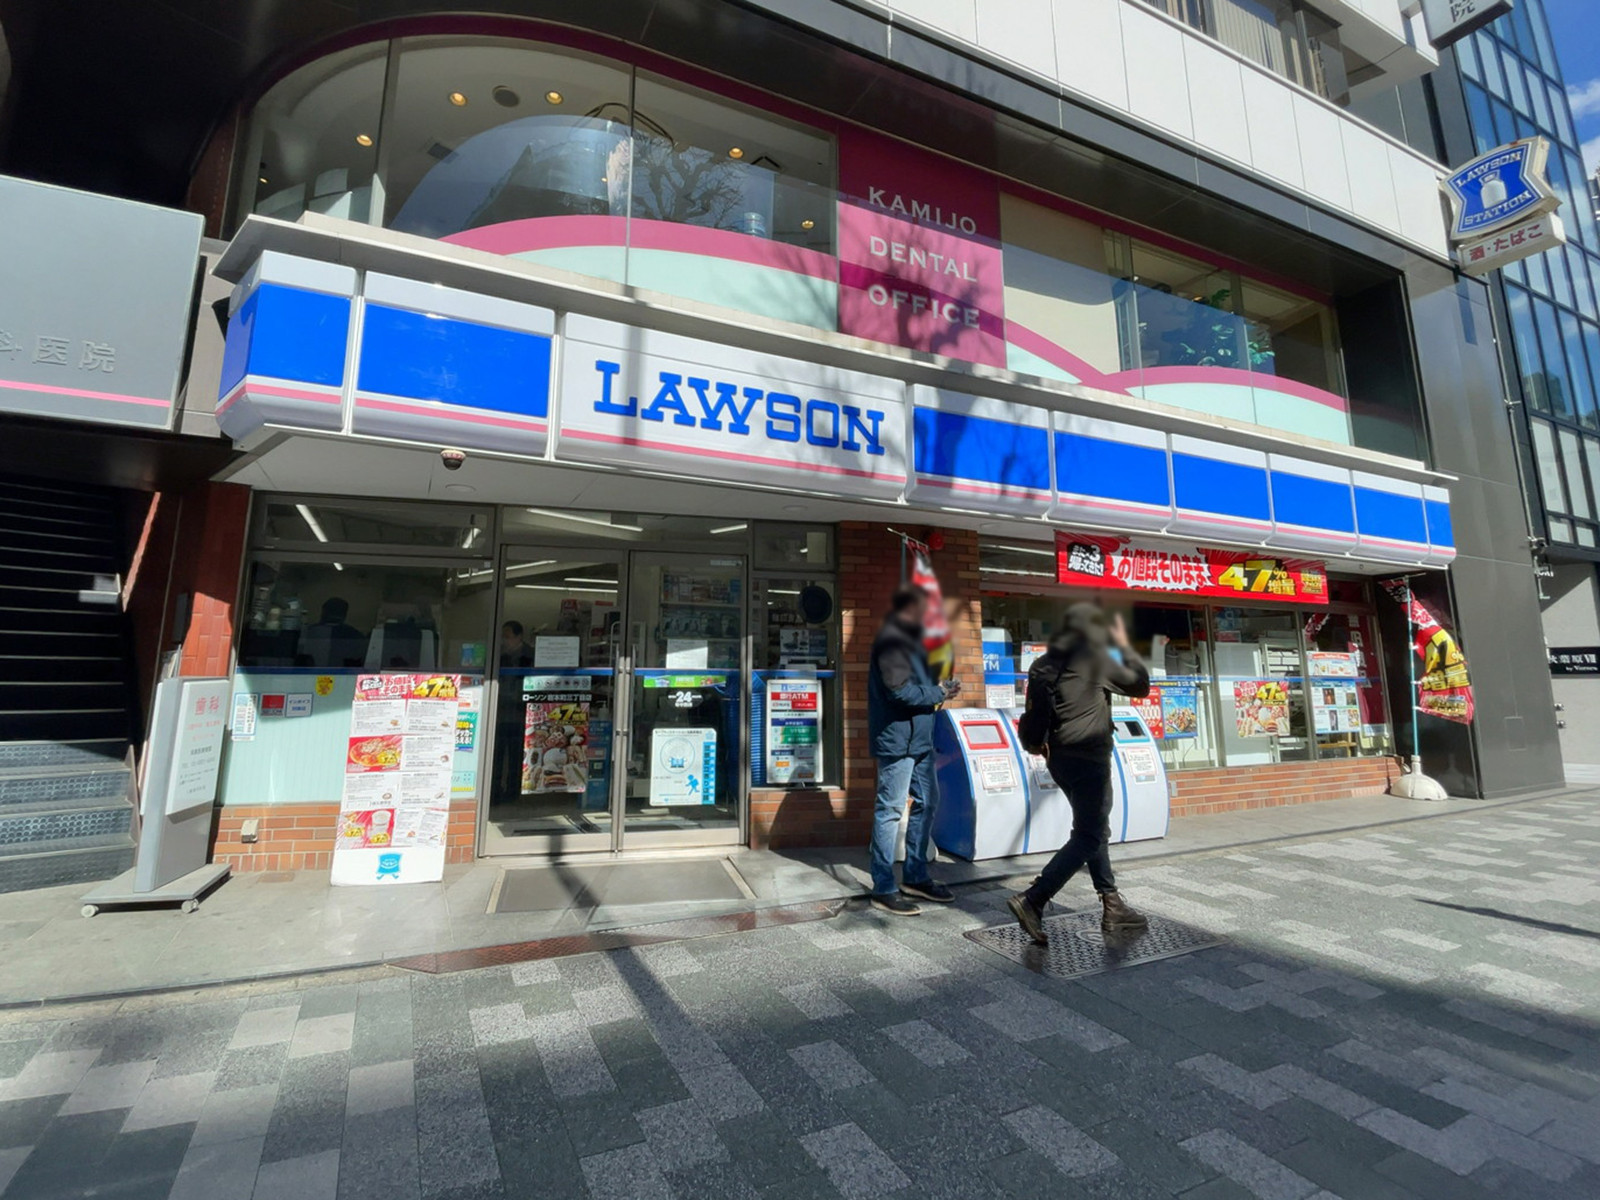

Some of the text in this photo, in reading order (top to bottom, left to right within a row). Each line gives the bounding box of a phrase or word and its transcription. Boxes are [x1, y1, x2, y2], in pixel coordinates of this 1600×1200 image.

[1455, 151, 1522, 187] LAWSON
[869, 186, 977, 235] KAMIJO
[1464, 190, 1532, 225] STATION
[870, 235, 977, 282] DENTAL
[868, 284, 980, 329] OFFICE
[593, 359, 885, 456] LAWSON
[1117, 547, 1209, 588] お値段そのまま
[675, 691, 693, 703] 24
